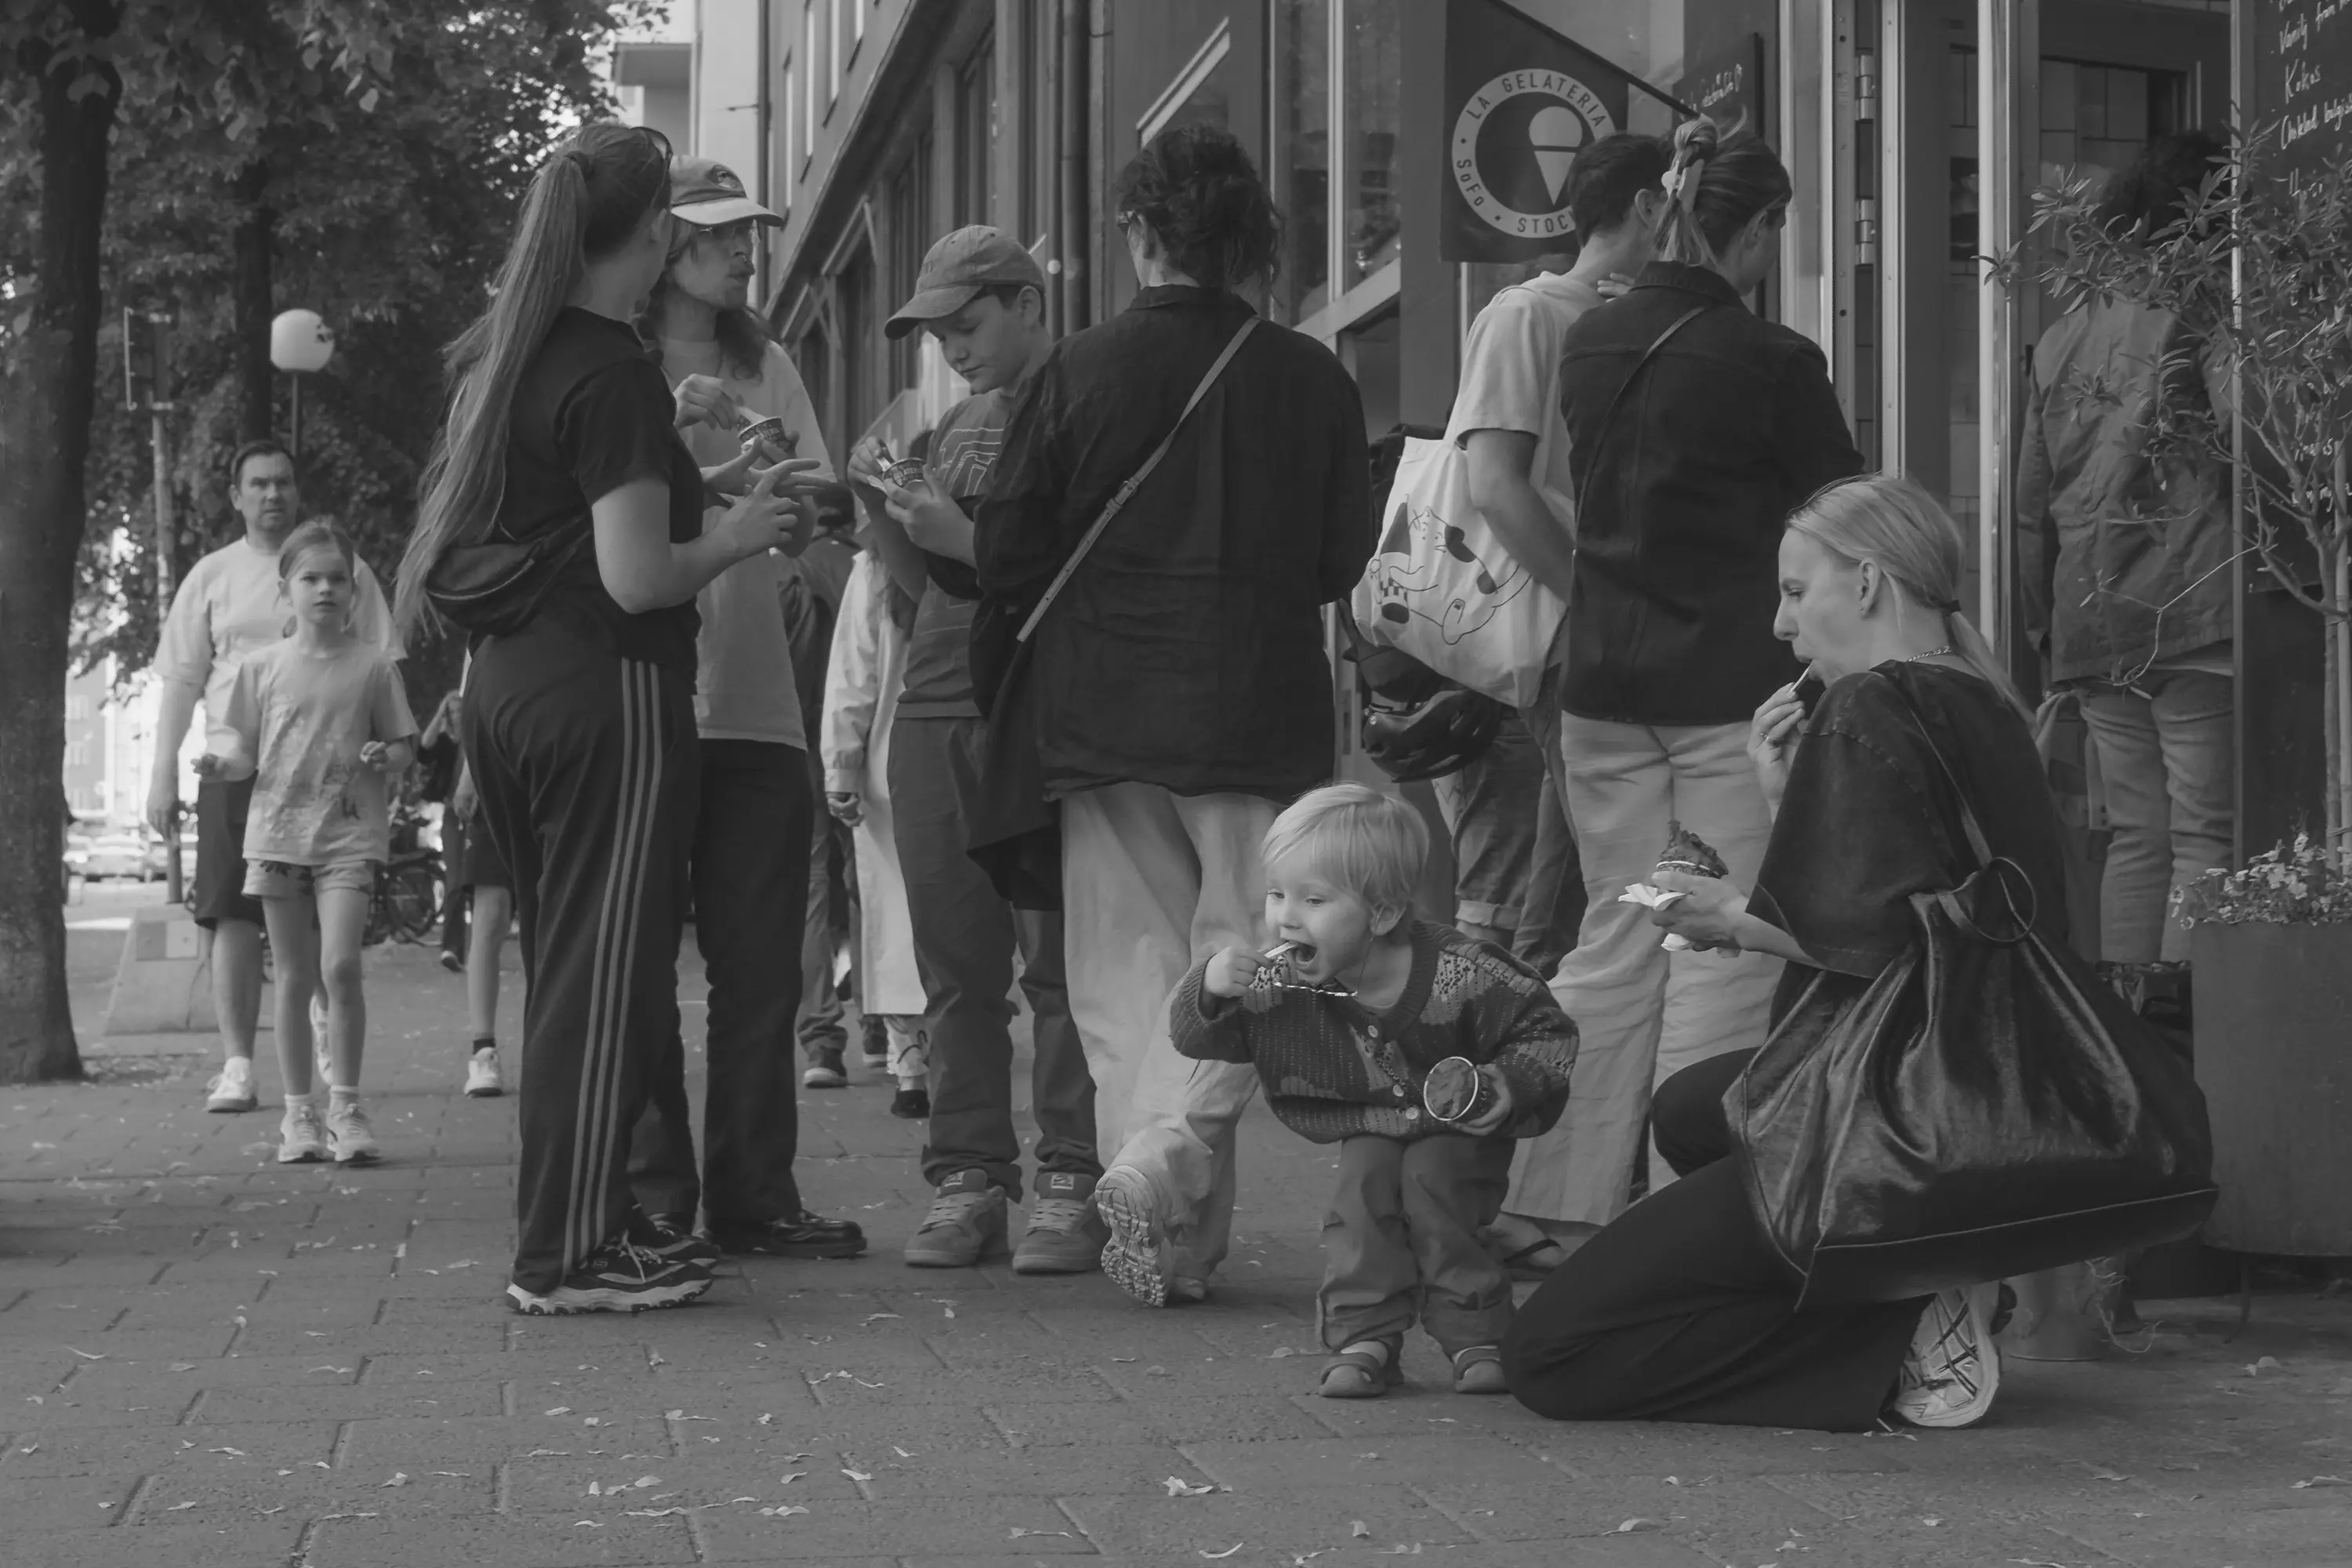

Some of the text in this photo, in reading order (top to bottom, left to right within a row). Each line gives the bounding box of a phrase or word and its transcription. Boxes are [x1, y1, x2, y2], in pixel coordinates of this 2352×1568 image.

[1466, 74, 1607, 128] LA GELATERIA
[2285, 58, 2322, 104] Kokos
